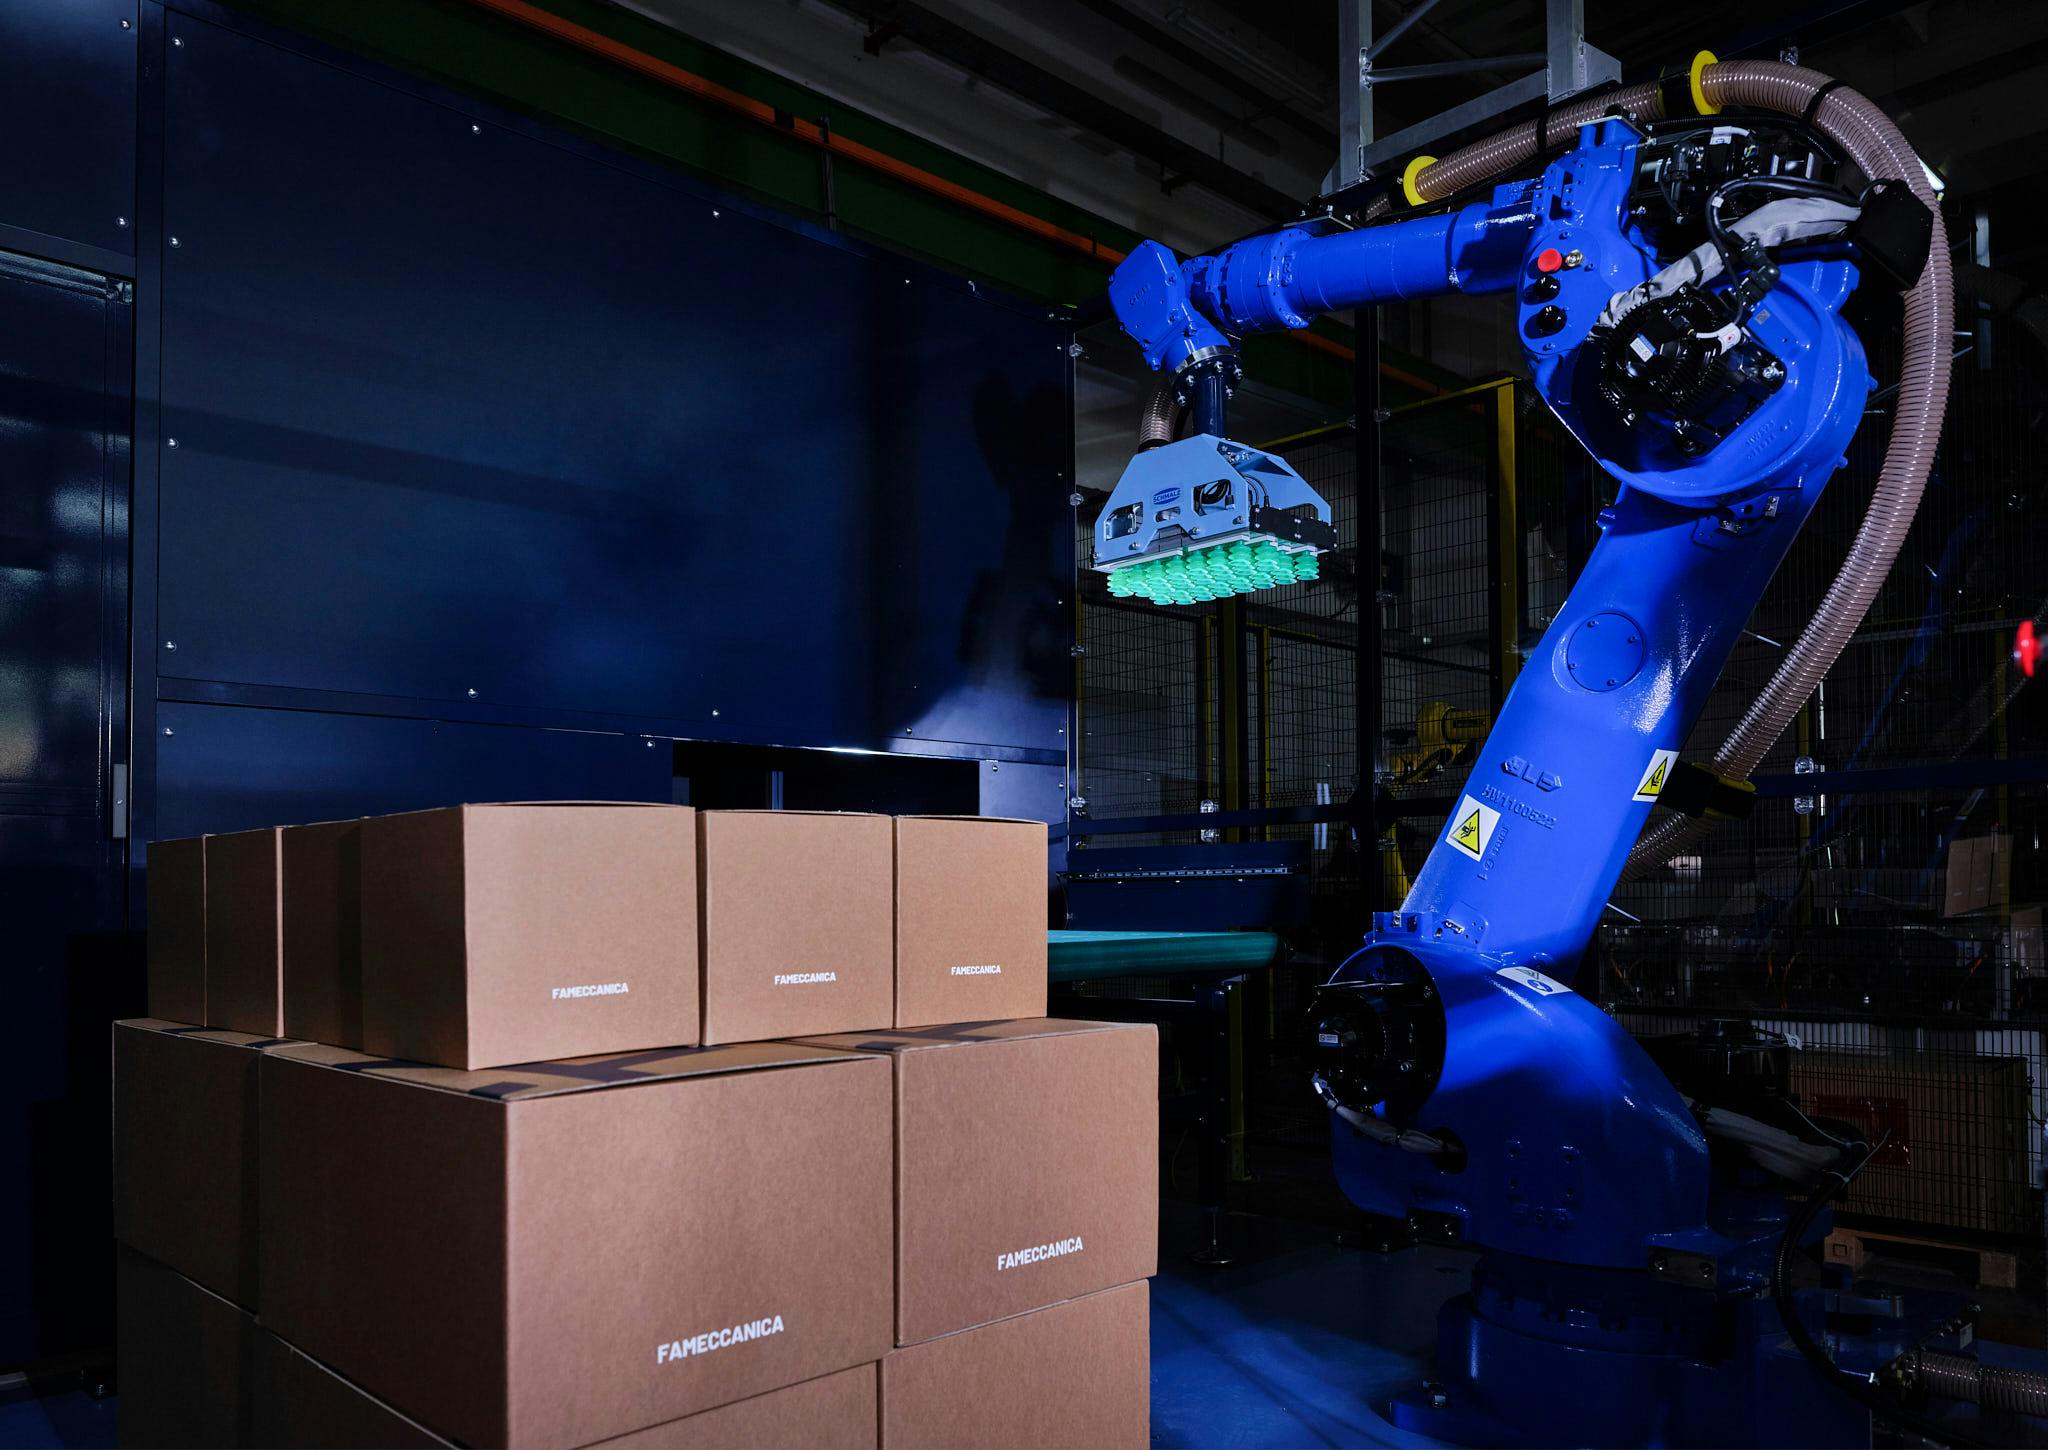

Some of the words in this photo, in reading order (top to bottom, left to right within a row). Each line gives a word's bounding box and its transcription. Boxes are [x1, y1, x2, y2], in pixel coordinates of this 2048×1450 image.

[1153, 488, 1181, 503] SCHMALZ
[774, 971, 837, 985] FAMECCANICA
[950, 964, 1002, 976] FAMECCANICA
[552, 983, 629, 1000] FAMECCANICA
[997, 1236, 1084, 1271] FAMECCANICA
[657, 1314, 785, 1364] FAMECCANICA
